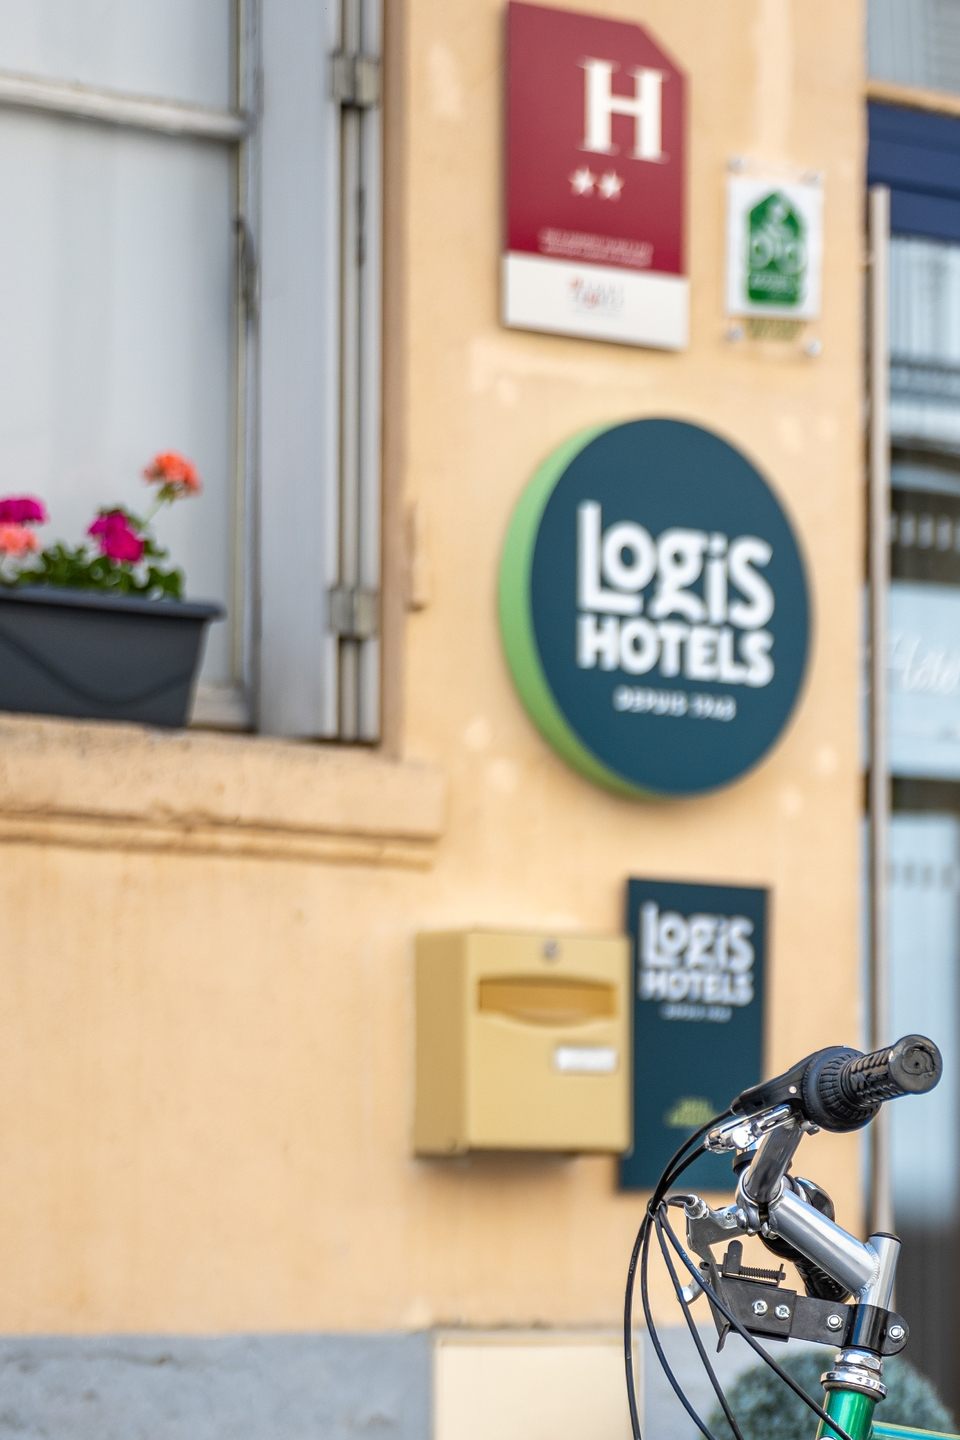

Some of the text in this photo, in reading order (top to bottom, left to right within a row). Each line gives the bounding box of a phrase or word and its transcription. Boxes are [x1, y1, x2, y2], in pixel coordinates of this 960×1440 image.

[578, 56, 669, 164] H
[576, 612, 775, 688] HOTELS
[639, 968, 755, 1007] HOTELS
